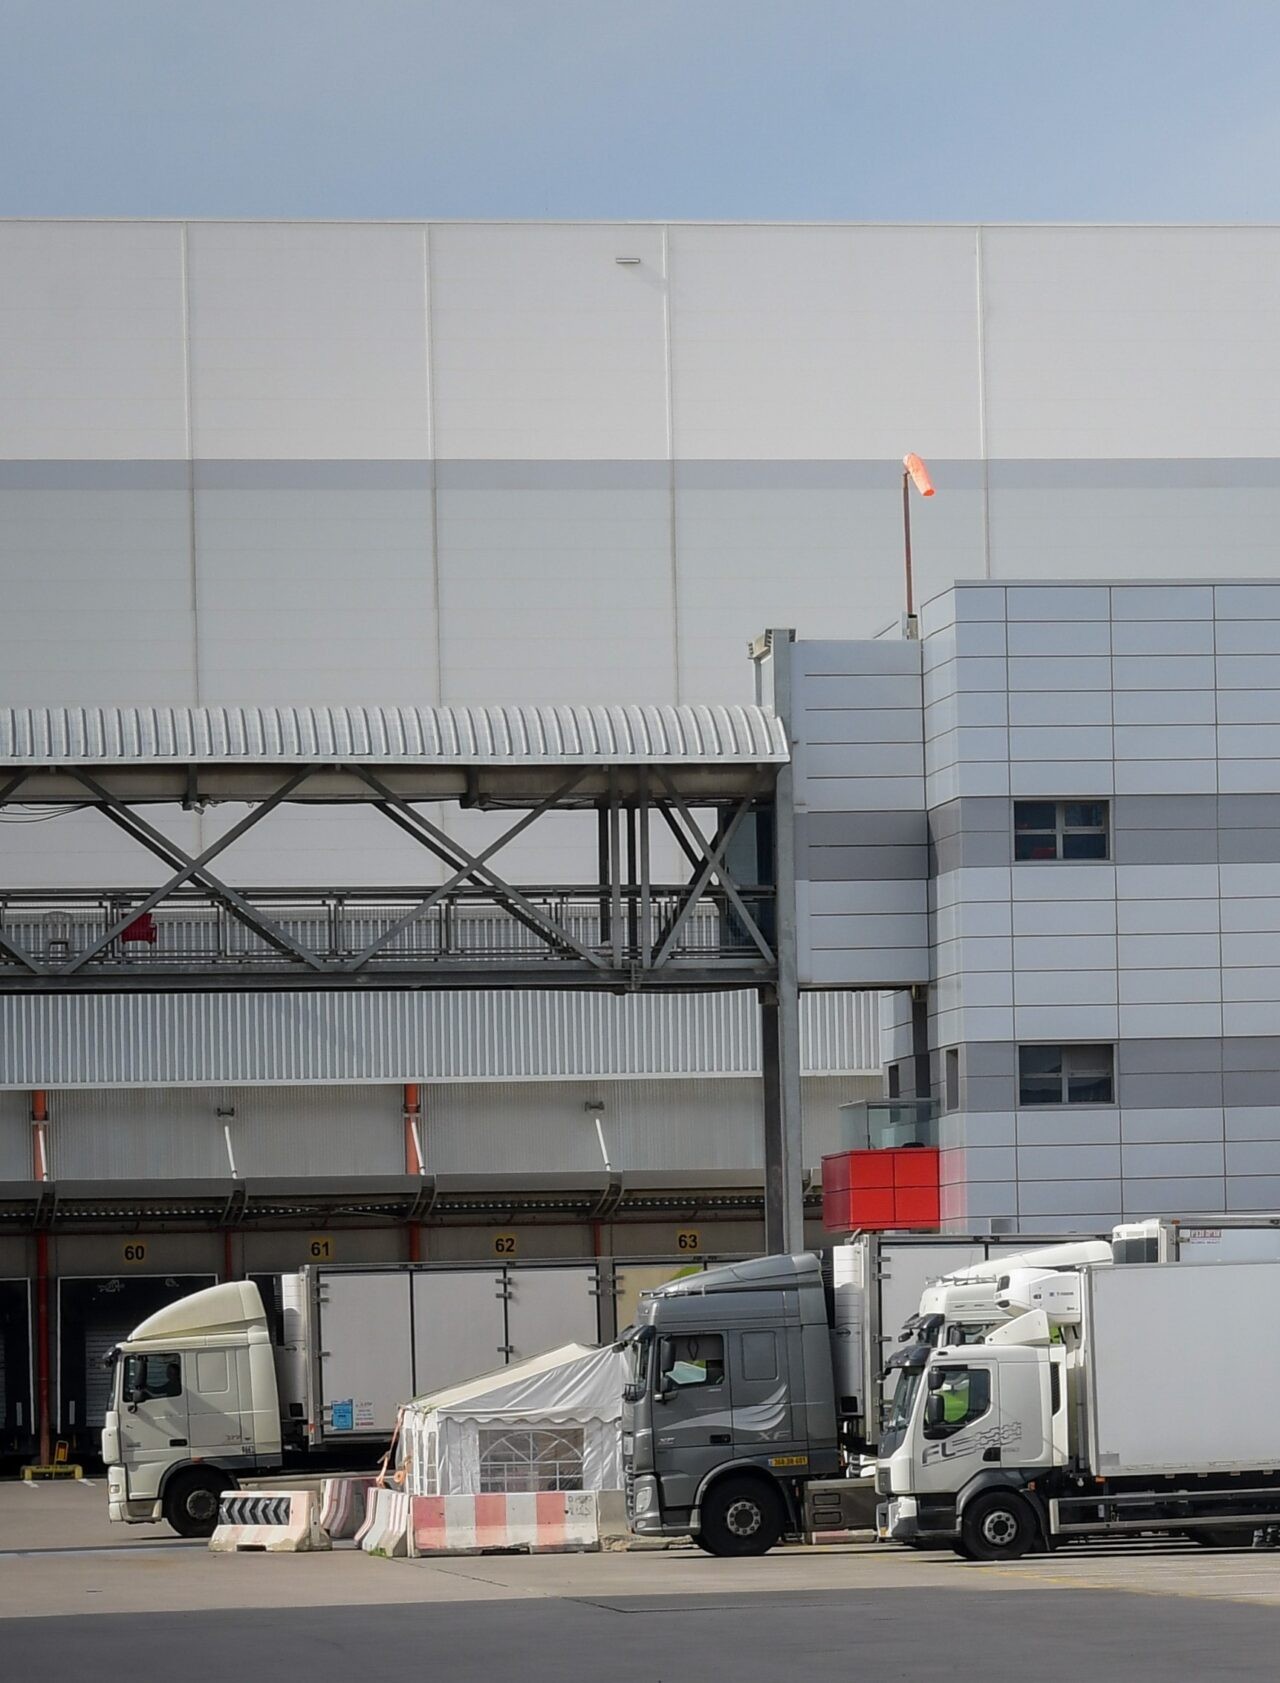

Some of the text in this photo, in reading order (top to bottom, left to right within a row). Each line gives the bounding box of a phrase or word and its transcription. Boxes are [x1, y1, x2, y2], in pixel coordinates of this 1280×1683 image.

[311, 1241, 330, 1257] 61
[495, 1237, 515, 1253] 62
[678, 1233, 698, 1249] 63
[124, 1245, 145, 1261] 60
[758, 1430, 790, 1441] XF
[921, 1442, 956, 1465] FL
